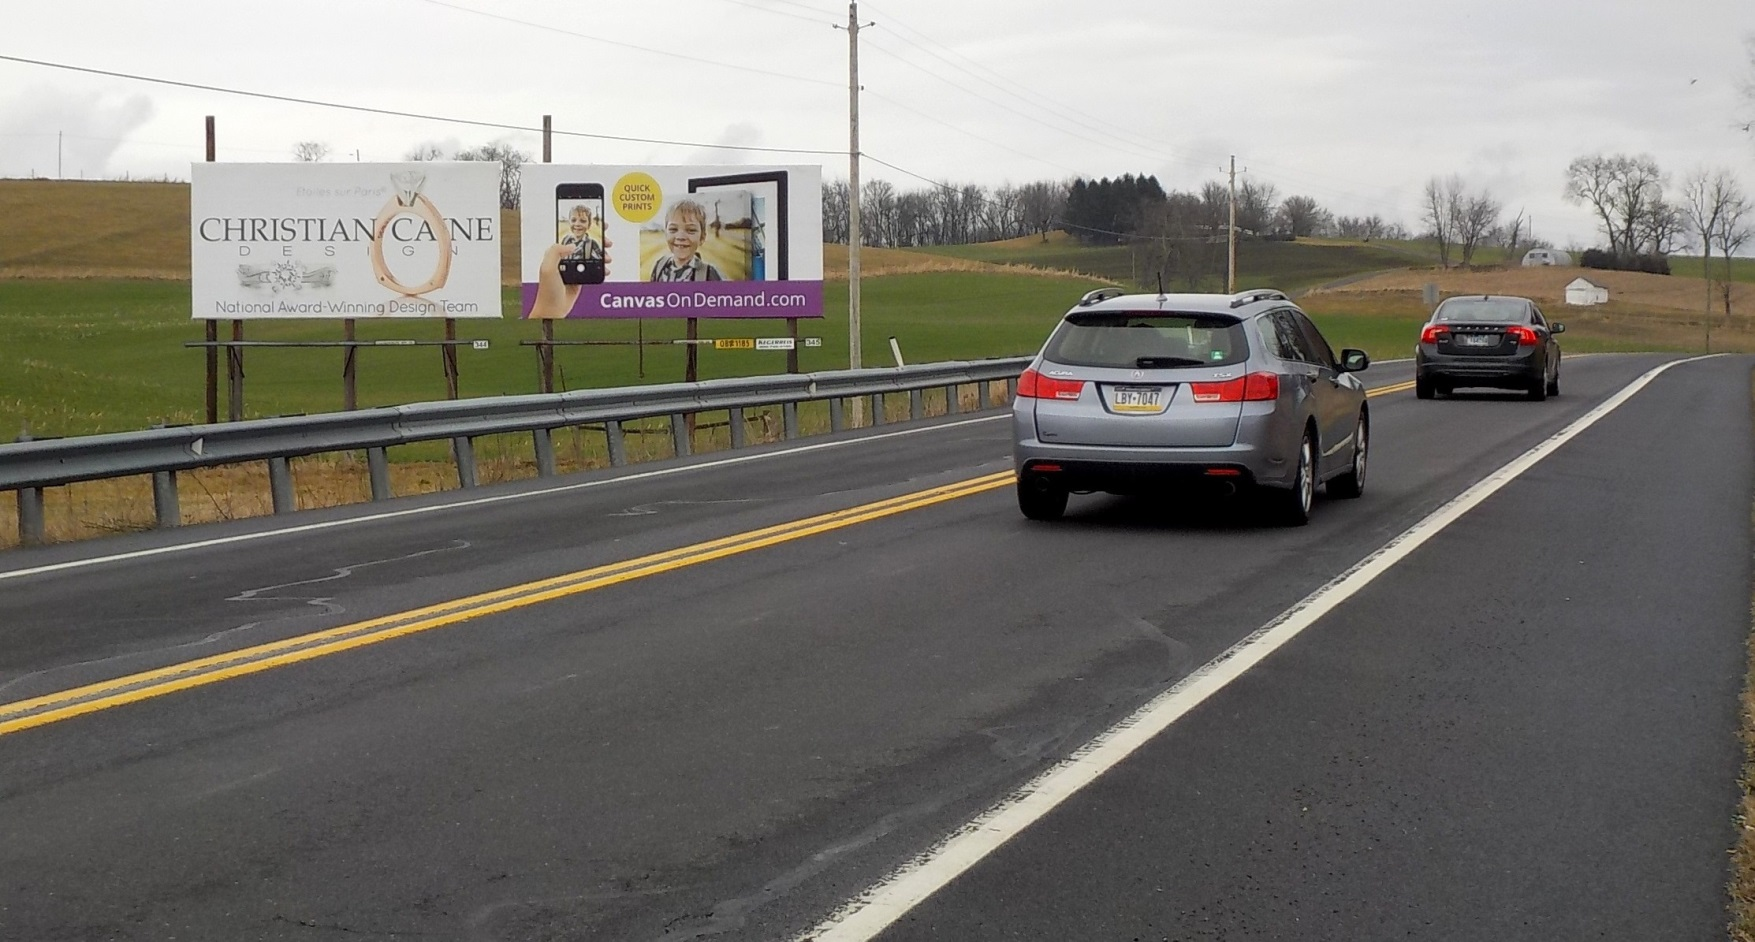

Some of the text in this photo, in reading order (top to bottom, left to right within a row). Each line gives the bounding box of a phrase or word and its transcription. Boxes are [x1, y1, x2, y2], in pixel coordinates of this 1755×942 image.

[624, 184, 651, 193] QUICK
[622, 202, 653, 210] PRINTS
[200, 217, 493, 242] CHRISTIAN CANE
[215, 301, 478, 315] National Award-Winning Design Team
